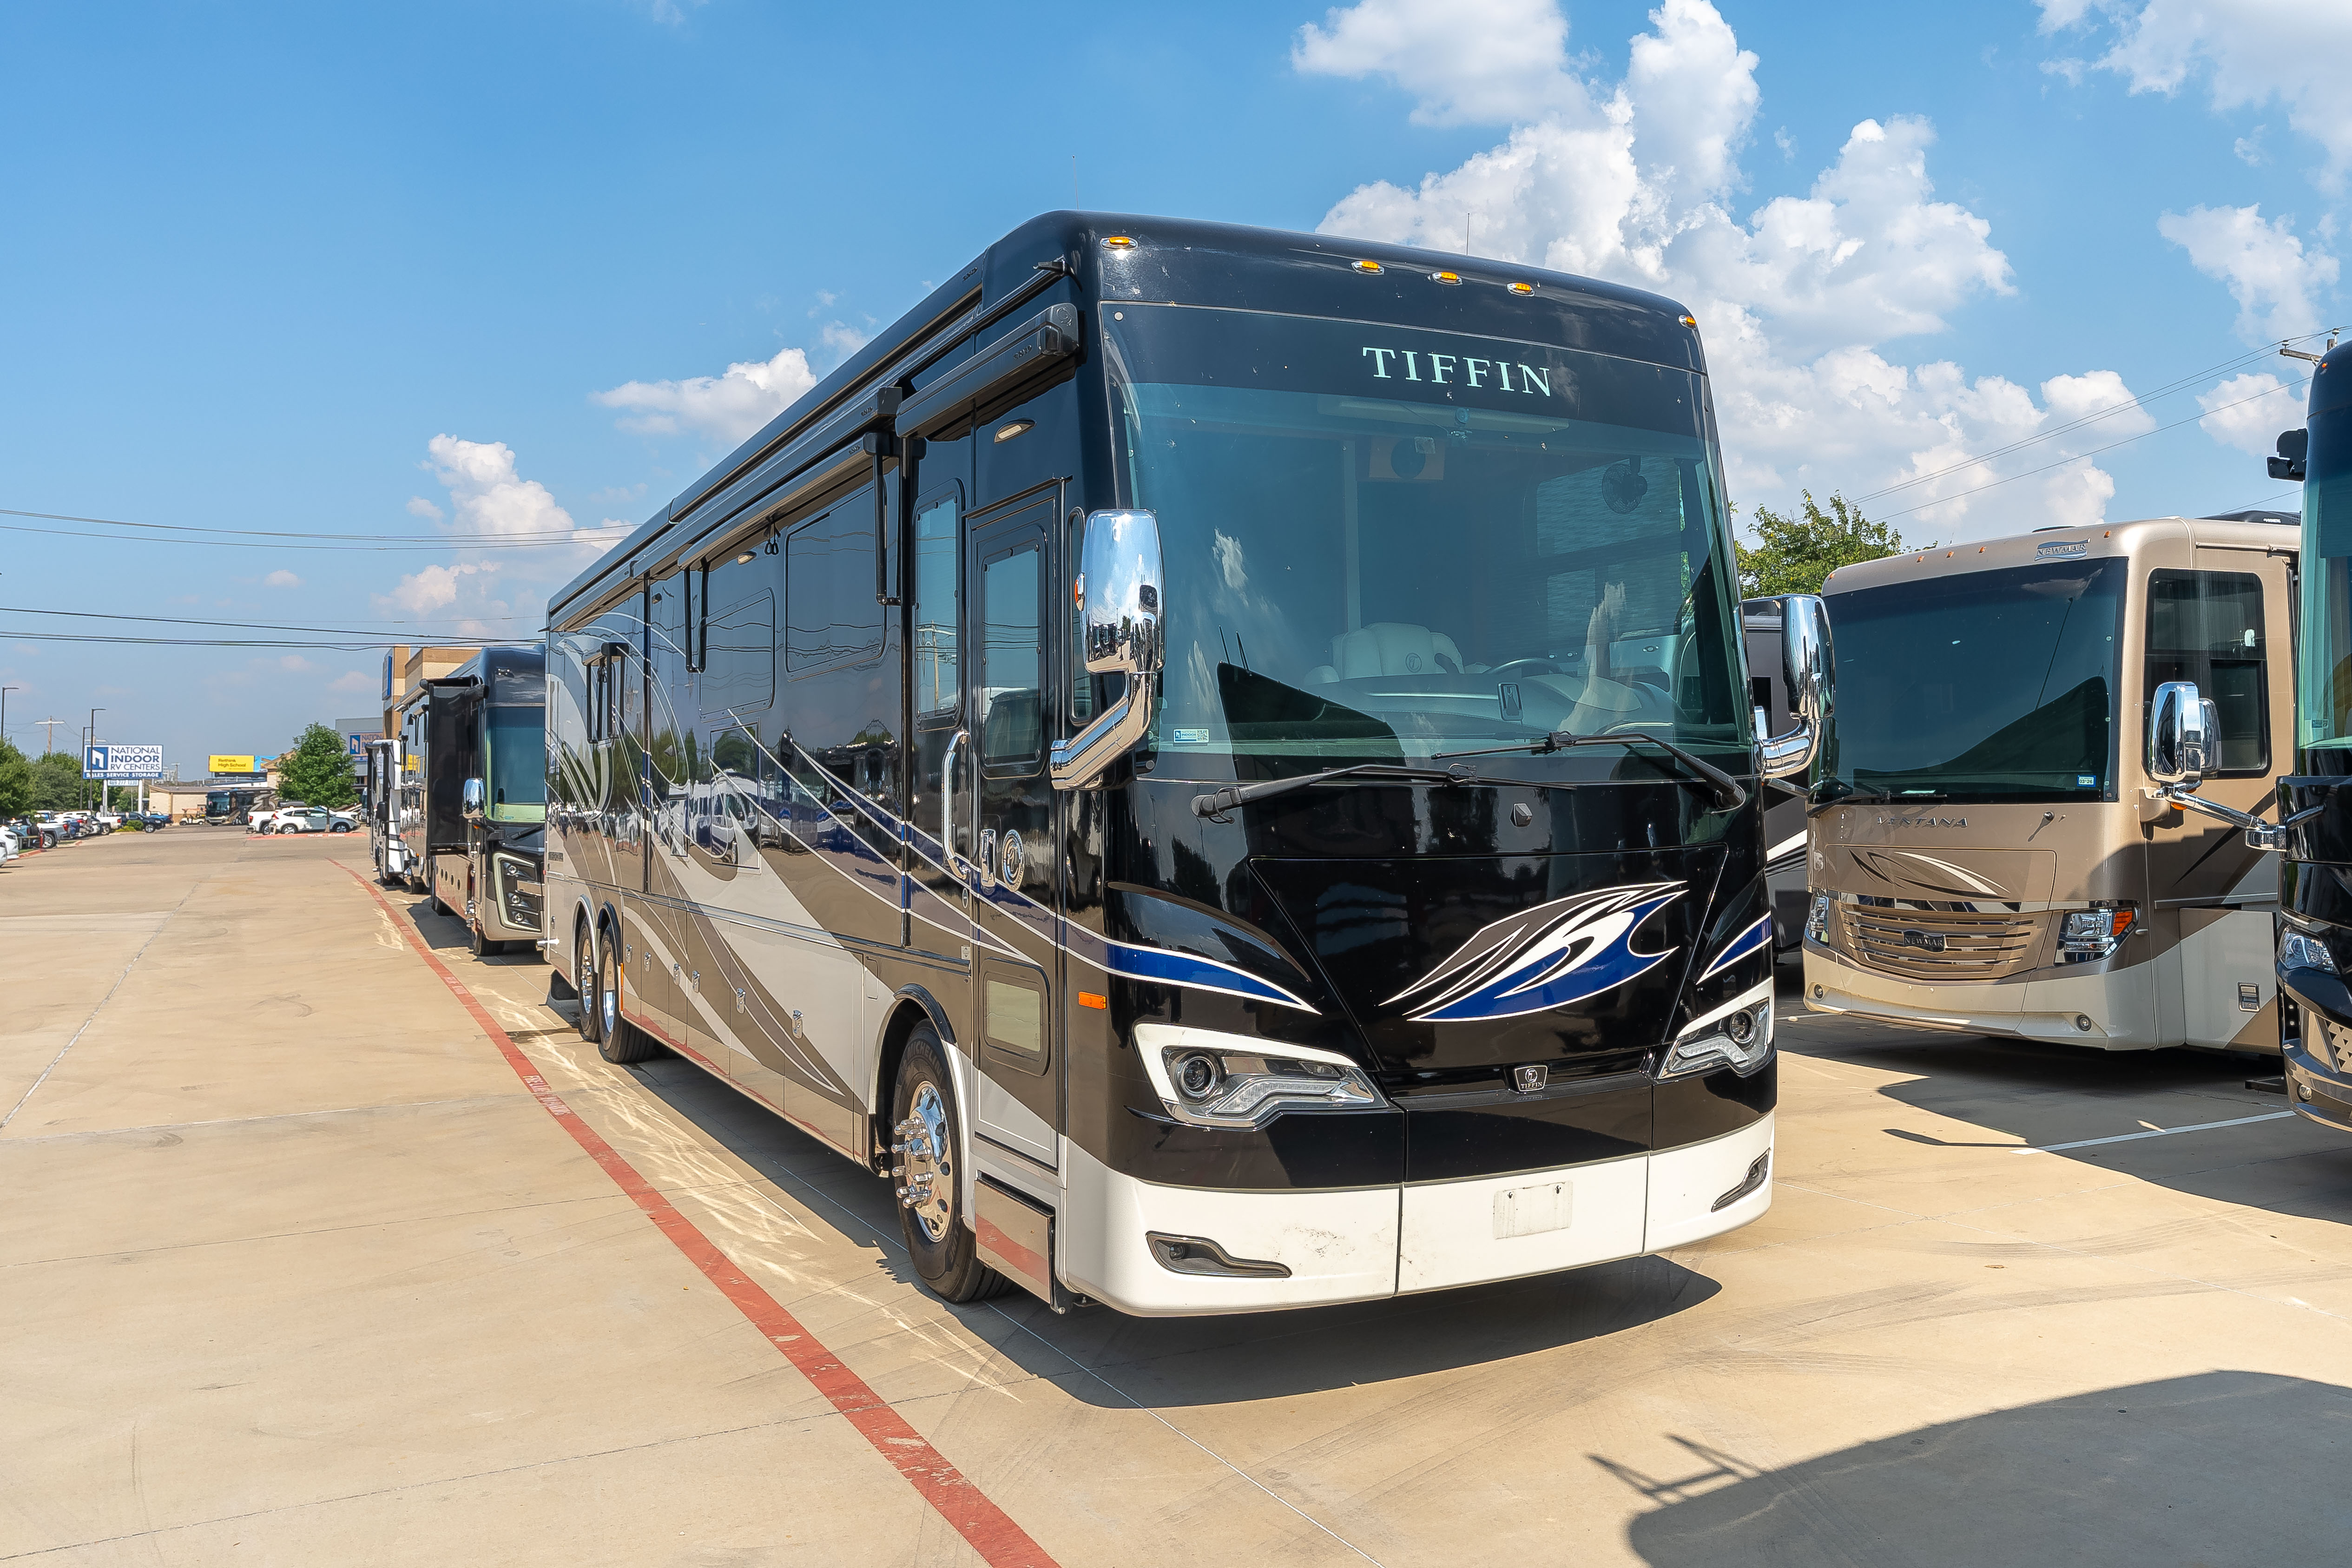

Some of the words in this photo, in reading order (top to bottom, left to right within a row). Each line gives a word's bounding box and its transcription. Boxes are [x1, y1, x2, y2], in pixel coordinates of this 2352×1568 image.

[1362, 347, 1550, 397] TIFFIN
[2036, 544, 2087, 556] NEWMAR
[1877, 817, 1968, 827] VENTANA
[1904, 937, 1943, 947] NEWMAR
[907, 1041, 942, 1076] MICHELIN
